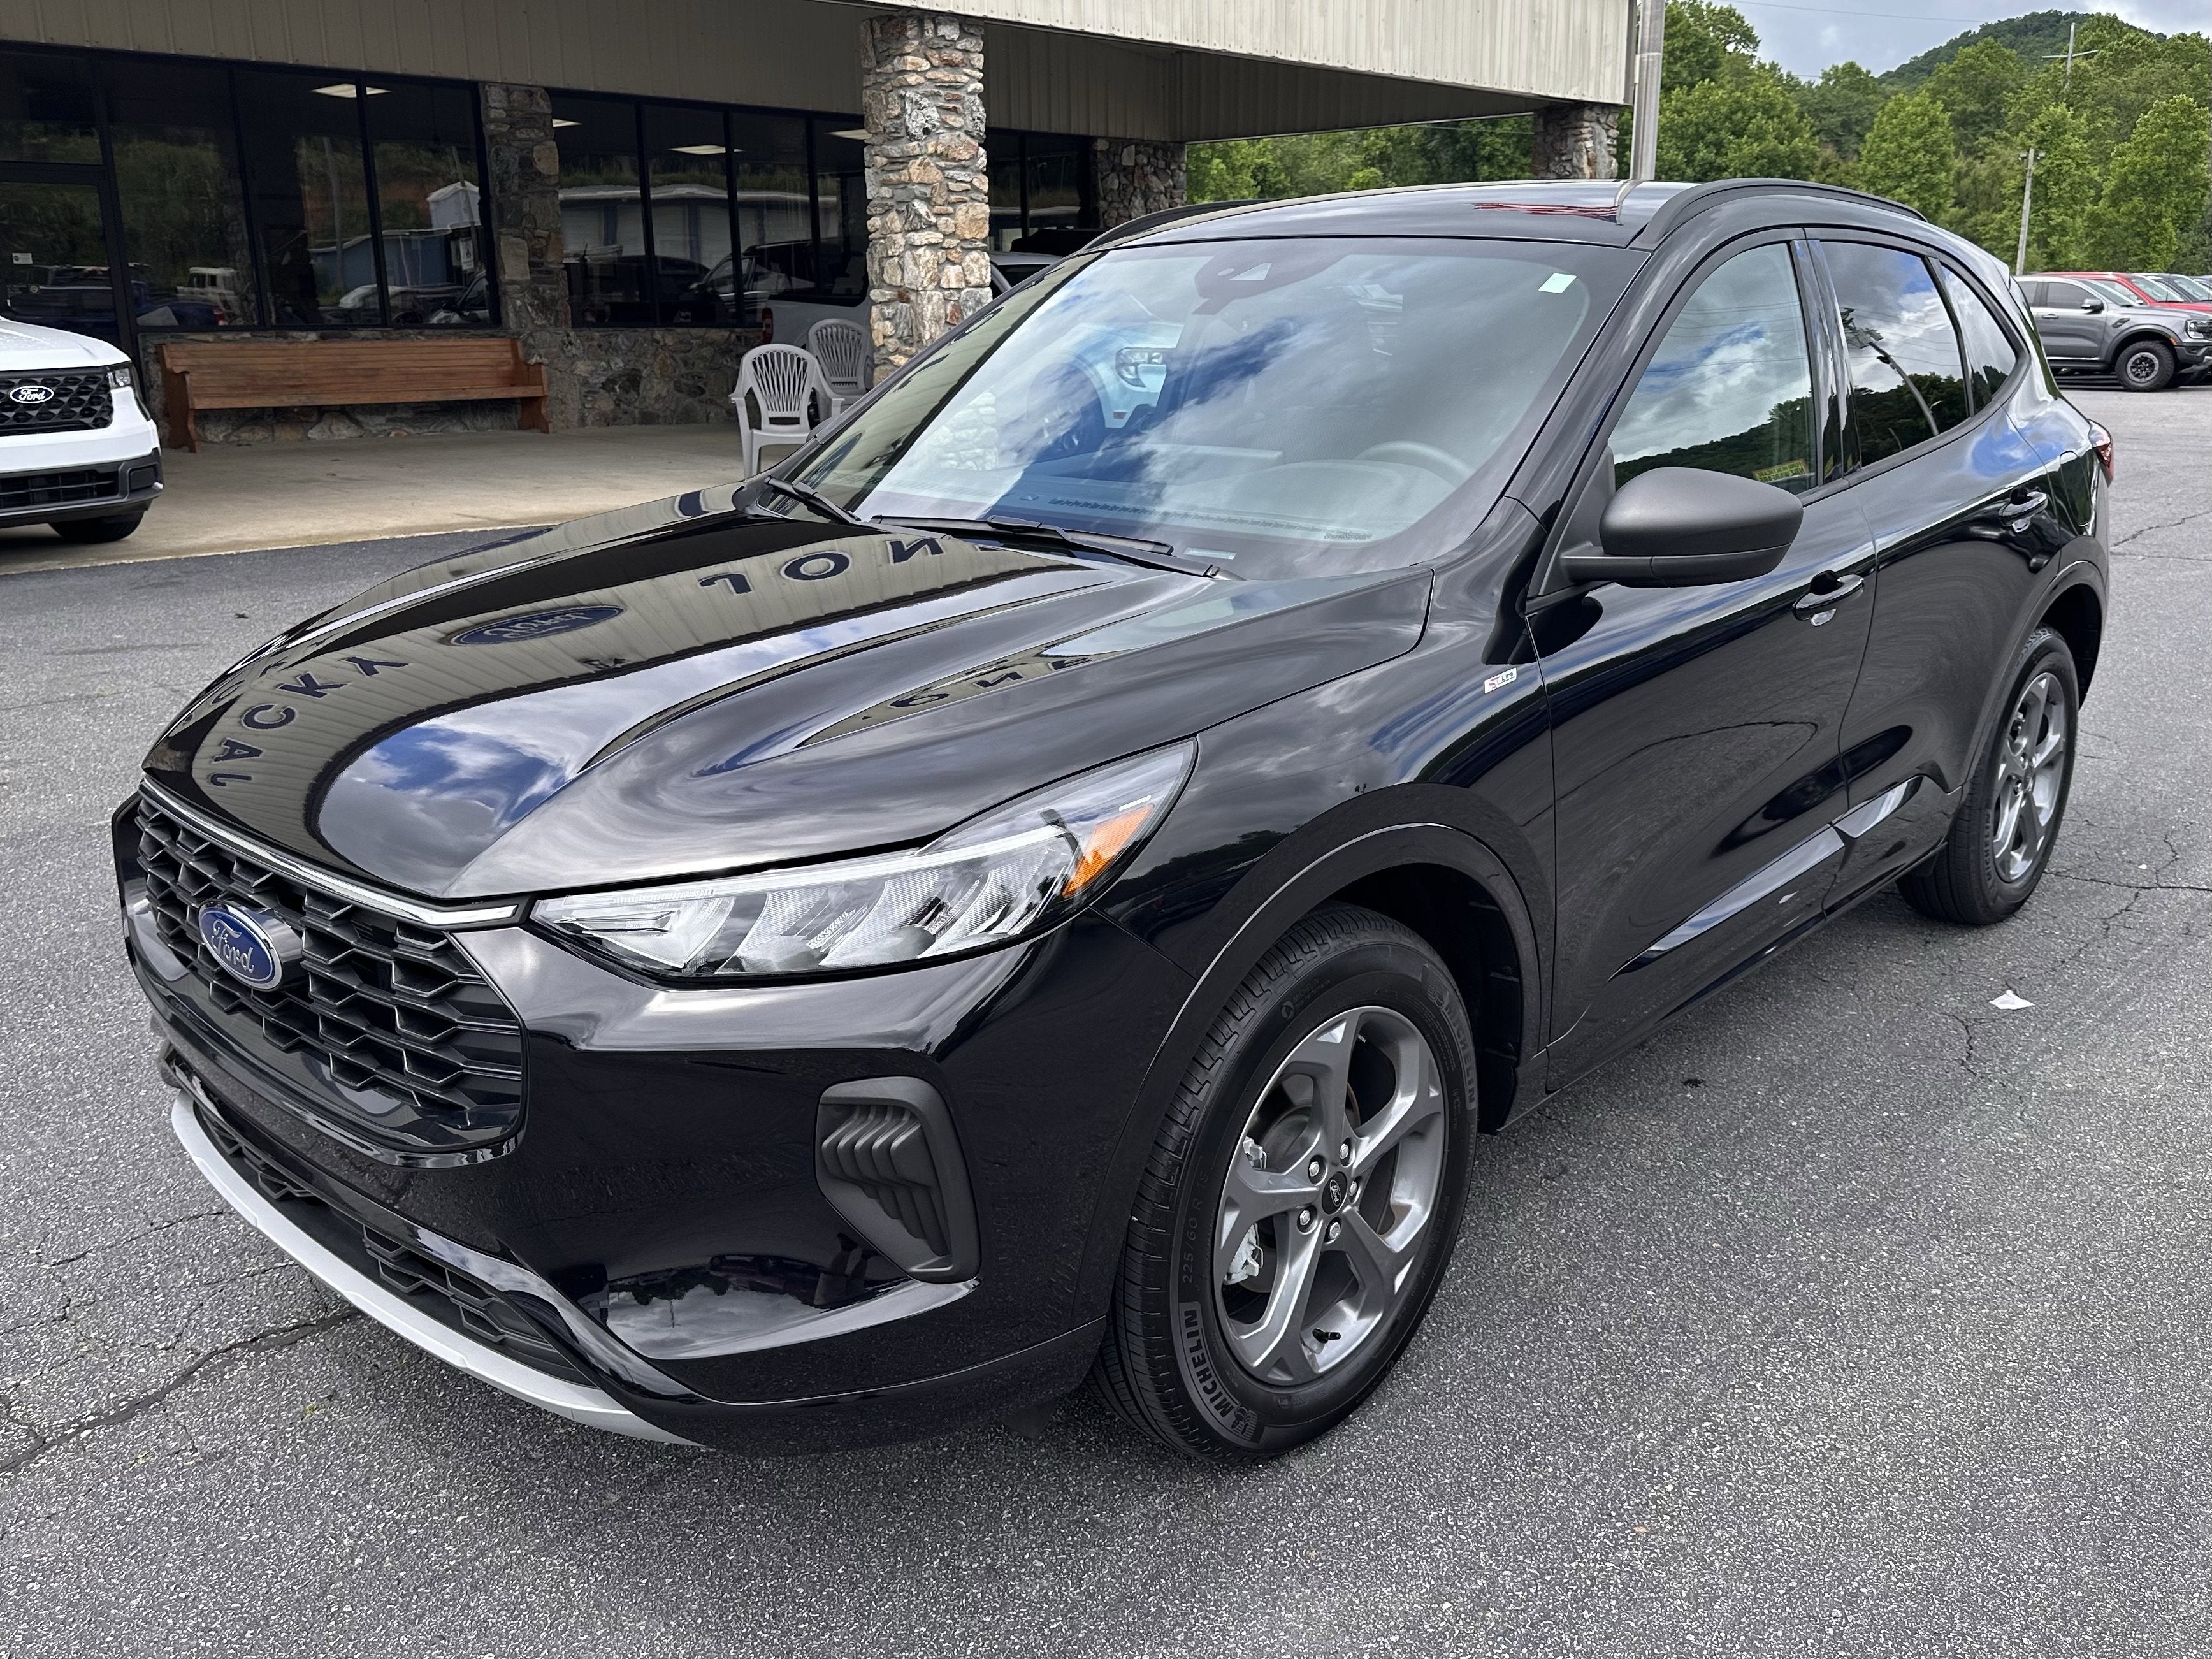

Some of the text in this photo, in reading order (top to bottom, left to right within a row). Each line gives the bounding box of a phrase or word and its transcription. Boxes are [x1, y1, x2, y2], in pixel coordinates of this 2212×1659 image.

[17, 387, 47, 402] Ford
[1984, 813, 1993, 882] MICHELIN
[210, 918, 256, 973] Ford
[1444, 1004, 1476, 1105] MICHELIN
[1331, 1185, 1340, 1204] Ford
[1182, 1217, 1198, 1284] 225/60
[1184, 1309, 1234, 1418] MICHELIN
